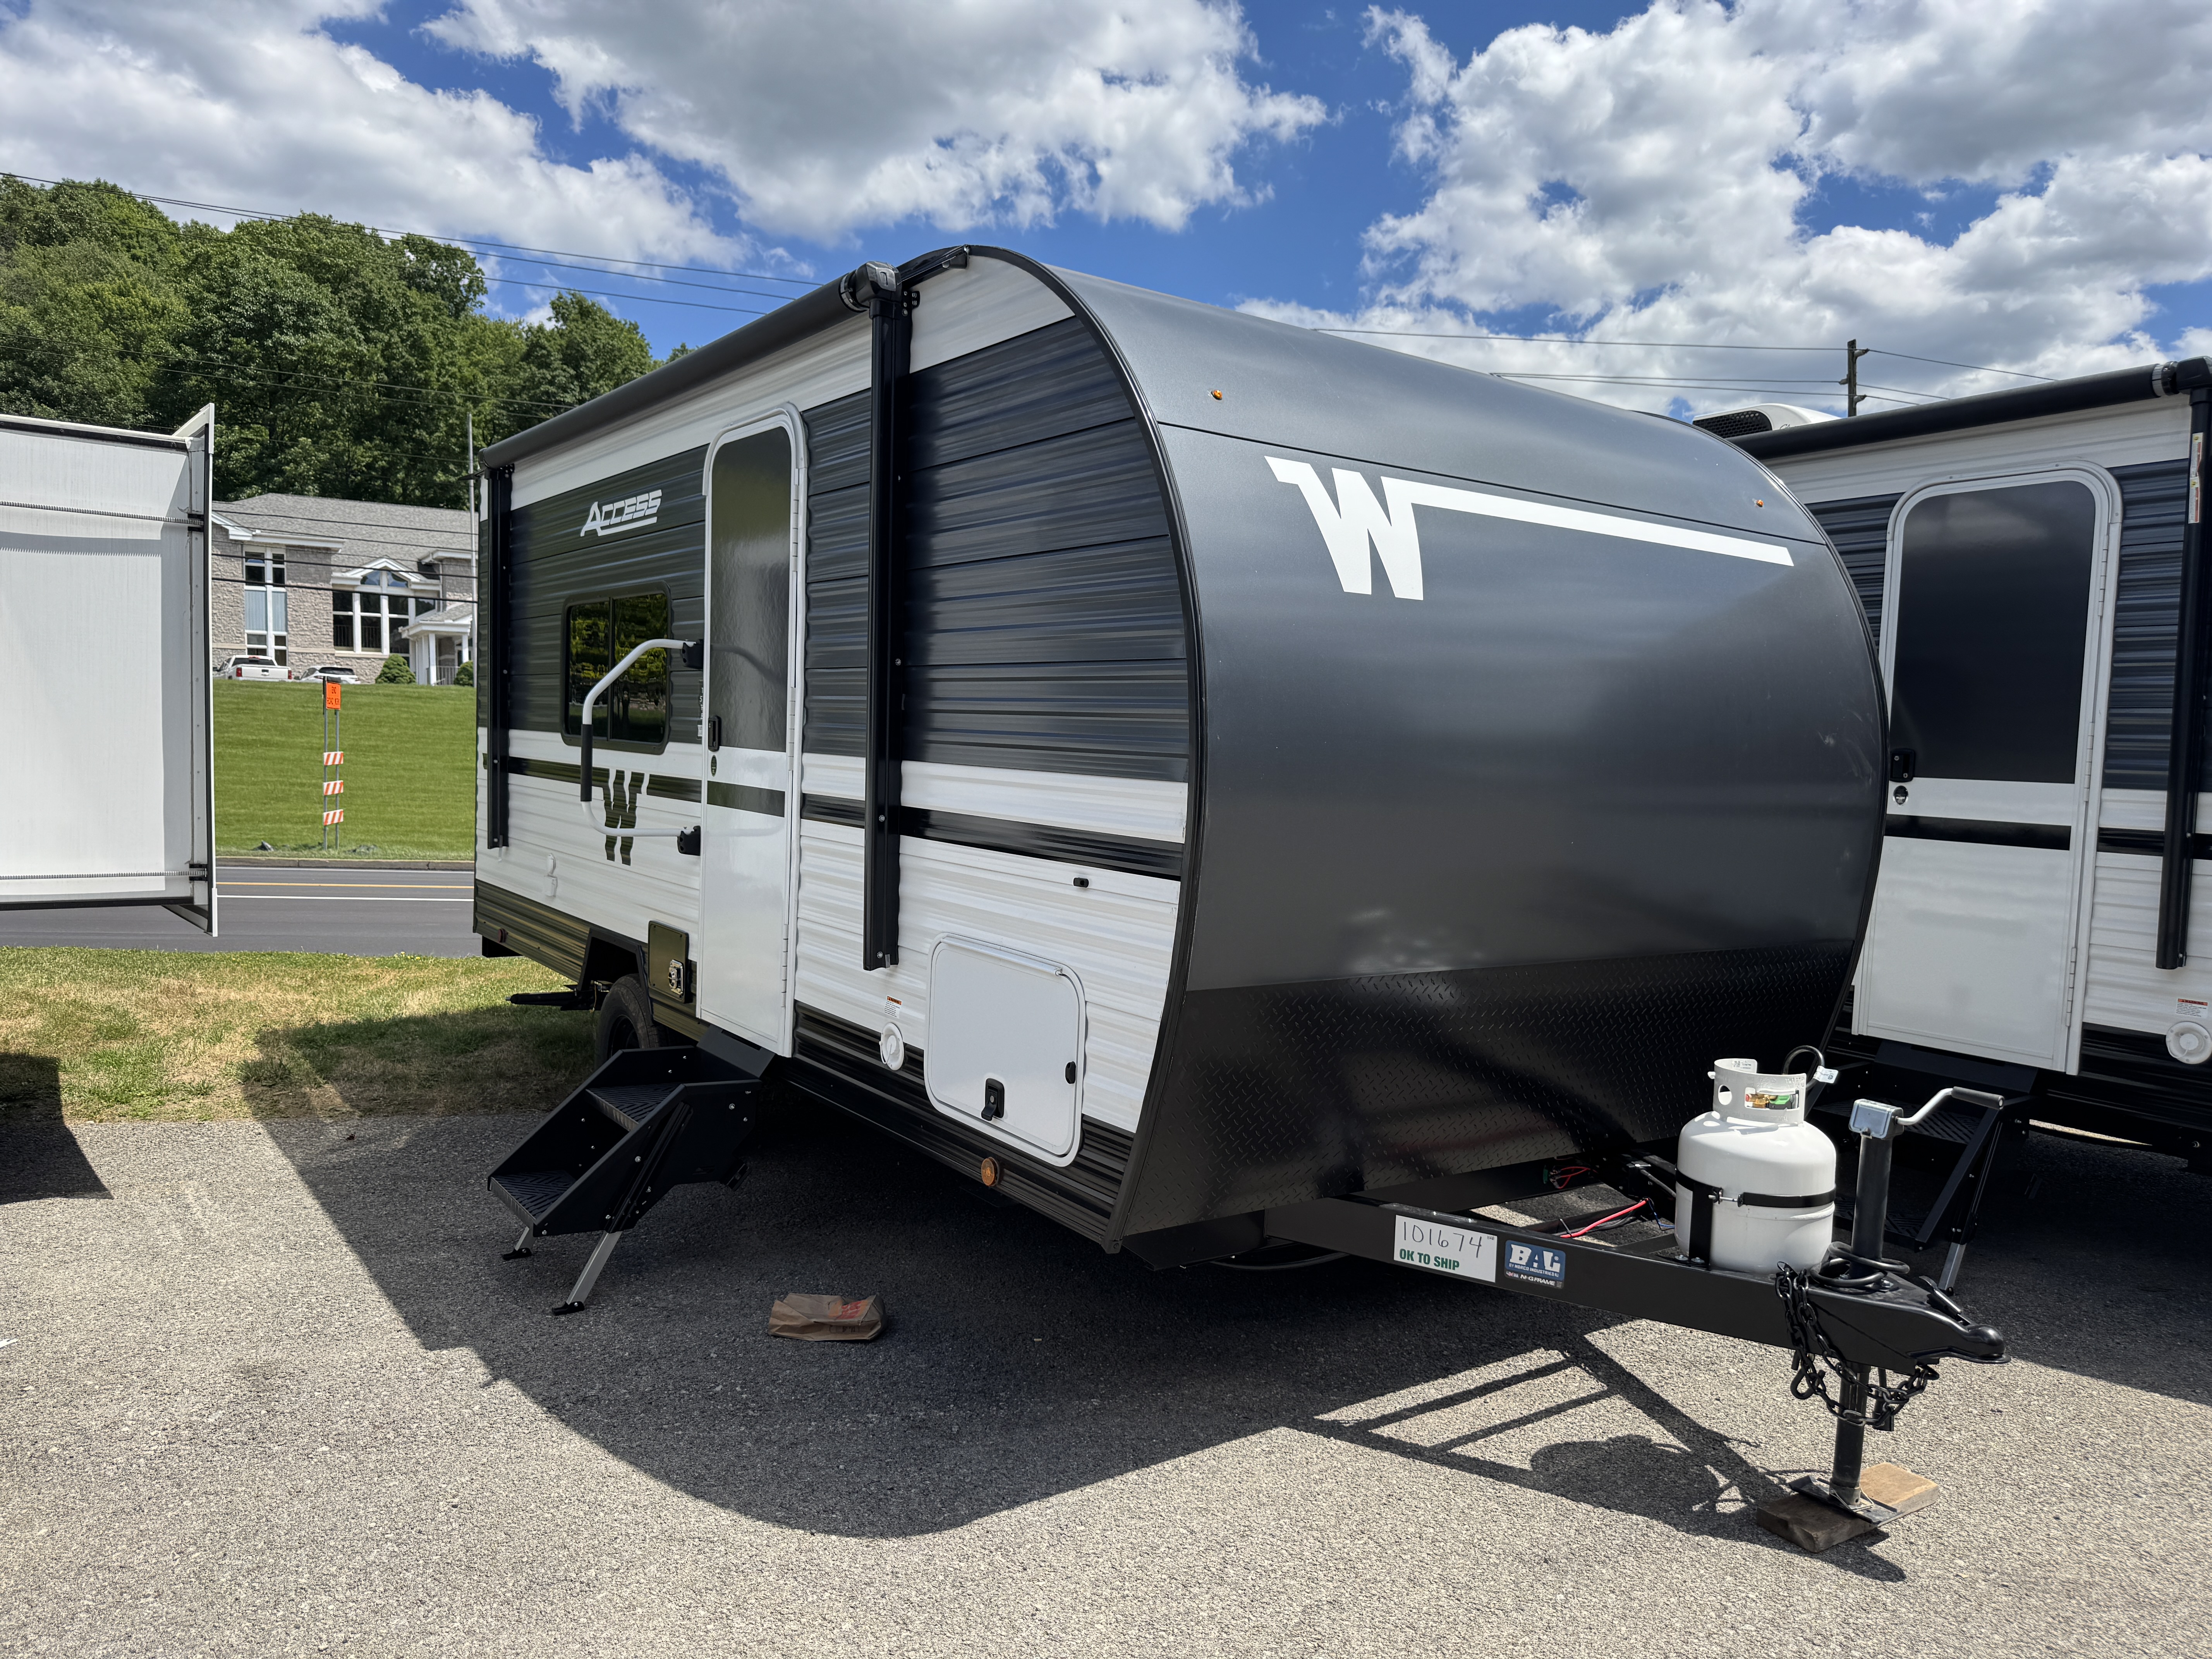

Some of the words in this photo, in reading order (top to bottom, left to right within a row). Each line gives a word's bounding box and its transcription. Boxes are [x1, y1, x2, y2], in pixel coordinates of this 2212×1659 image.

[1403, 1221, 1482, 1258] 101674
[1399, 1248, 1414, 1262] OK
[1417, 1252, 1431, 1265] TO
[1434, 1256, 1460, 1271] SHIP
